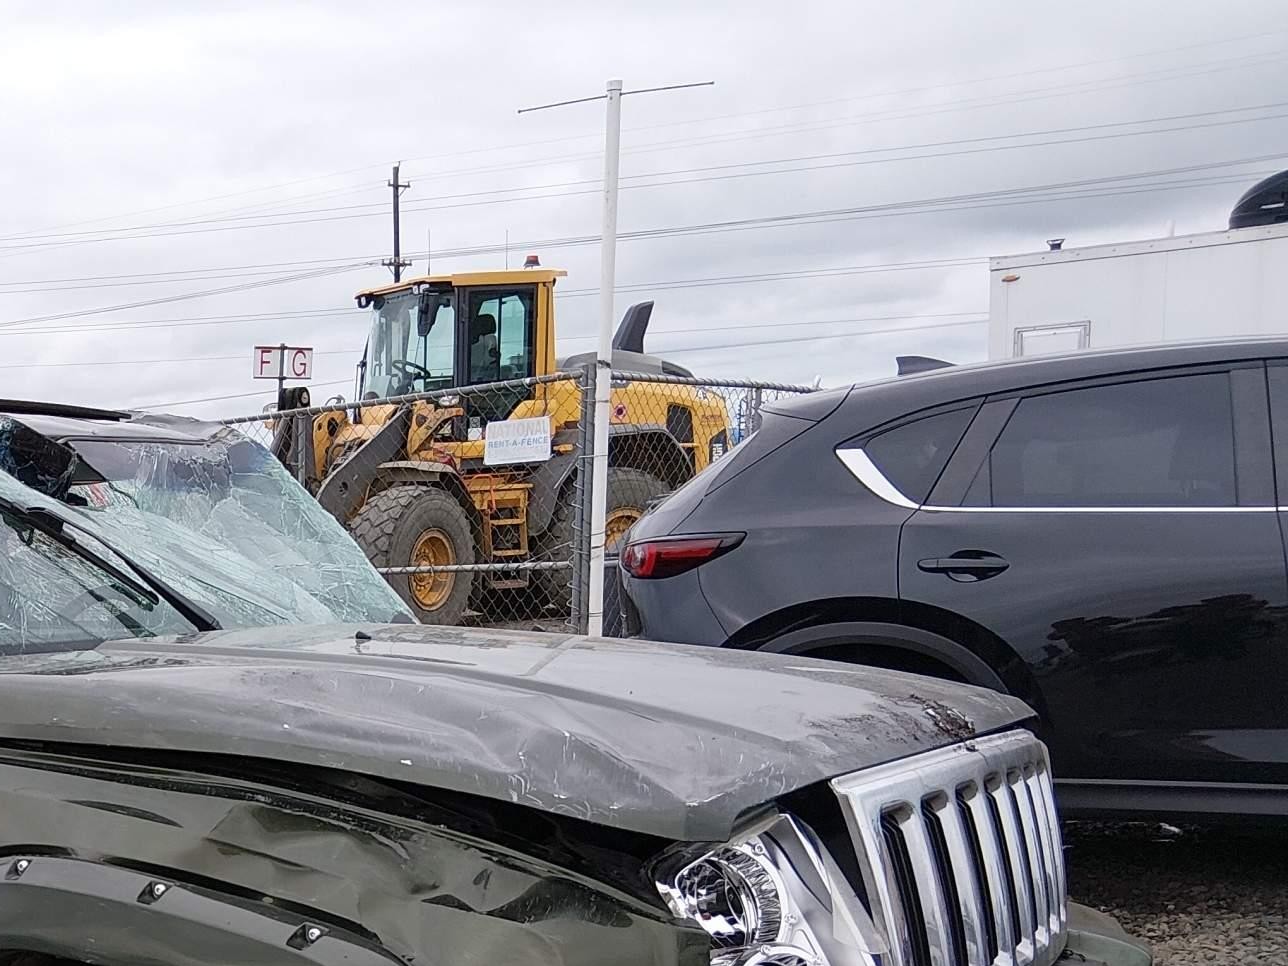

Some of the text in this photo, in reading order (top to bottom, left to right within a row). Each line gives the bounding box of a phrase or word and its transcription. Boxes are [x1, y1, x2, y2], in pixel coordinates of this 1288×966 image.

[259, 349, 272, 376] F
[292, 350, 307, 377] G
[488, 419, 549, 438] NATIONAL
[488, 436, 549, 449] RENT-A-FENCE
